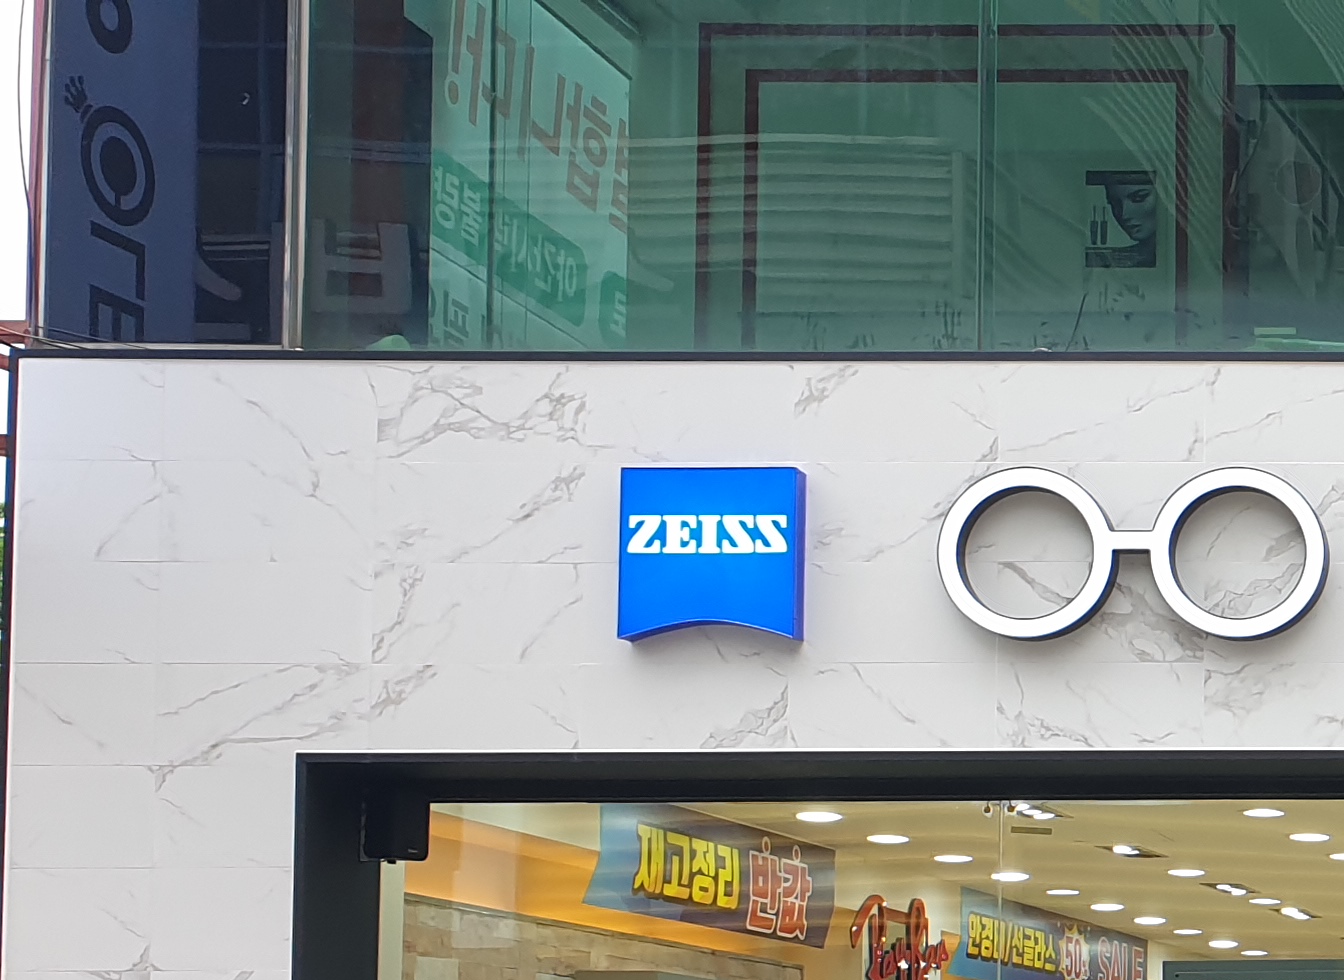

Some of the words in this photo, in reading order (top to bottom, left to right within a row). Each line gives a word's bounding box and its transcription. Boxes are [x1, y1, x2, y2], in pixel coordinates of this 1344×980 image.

[626, 513, 788, 555] ZEISS
[633, 823, 740, 910] 재고정리
[746, 836, 812, 940] 반값
